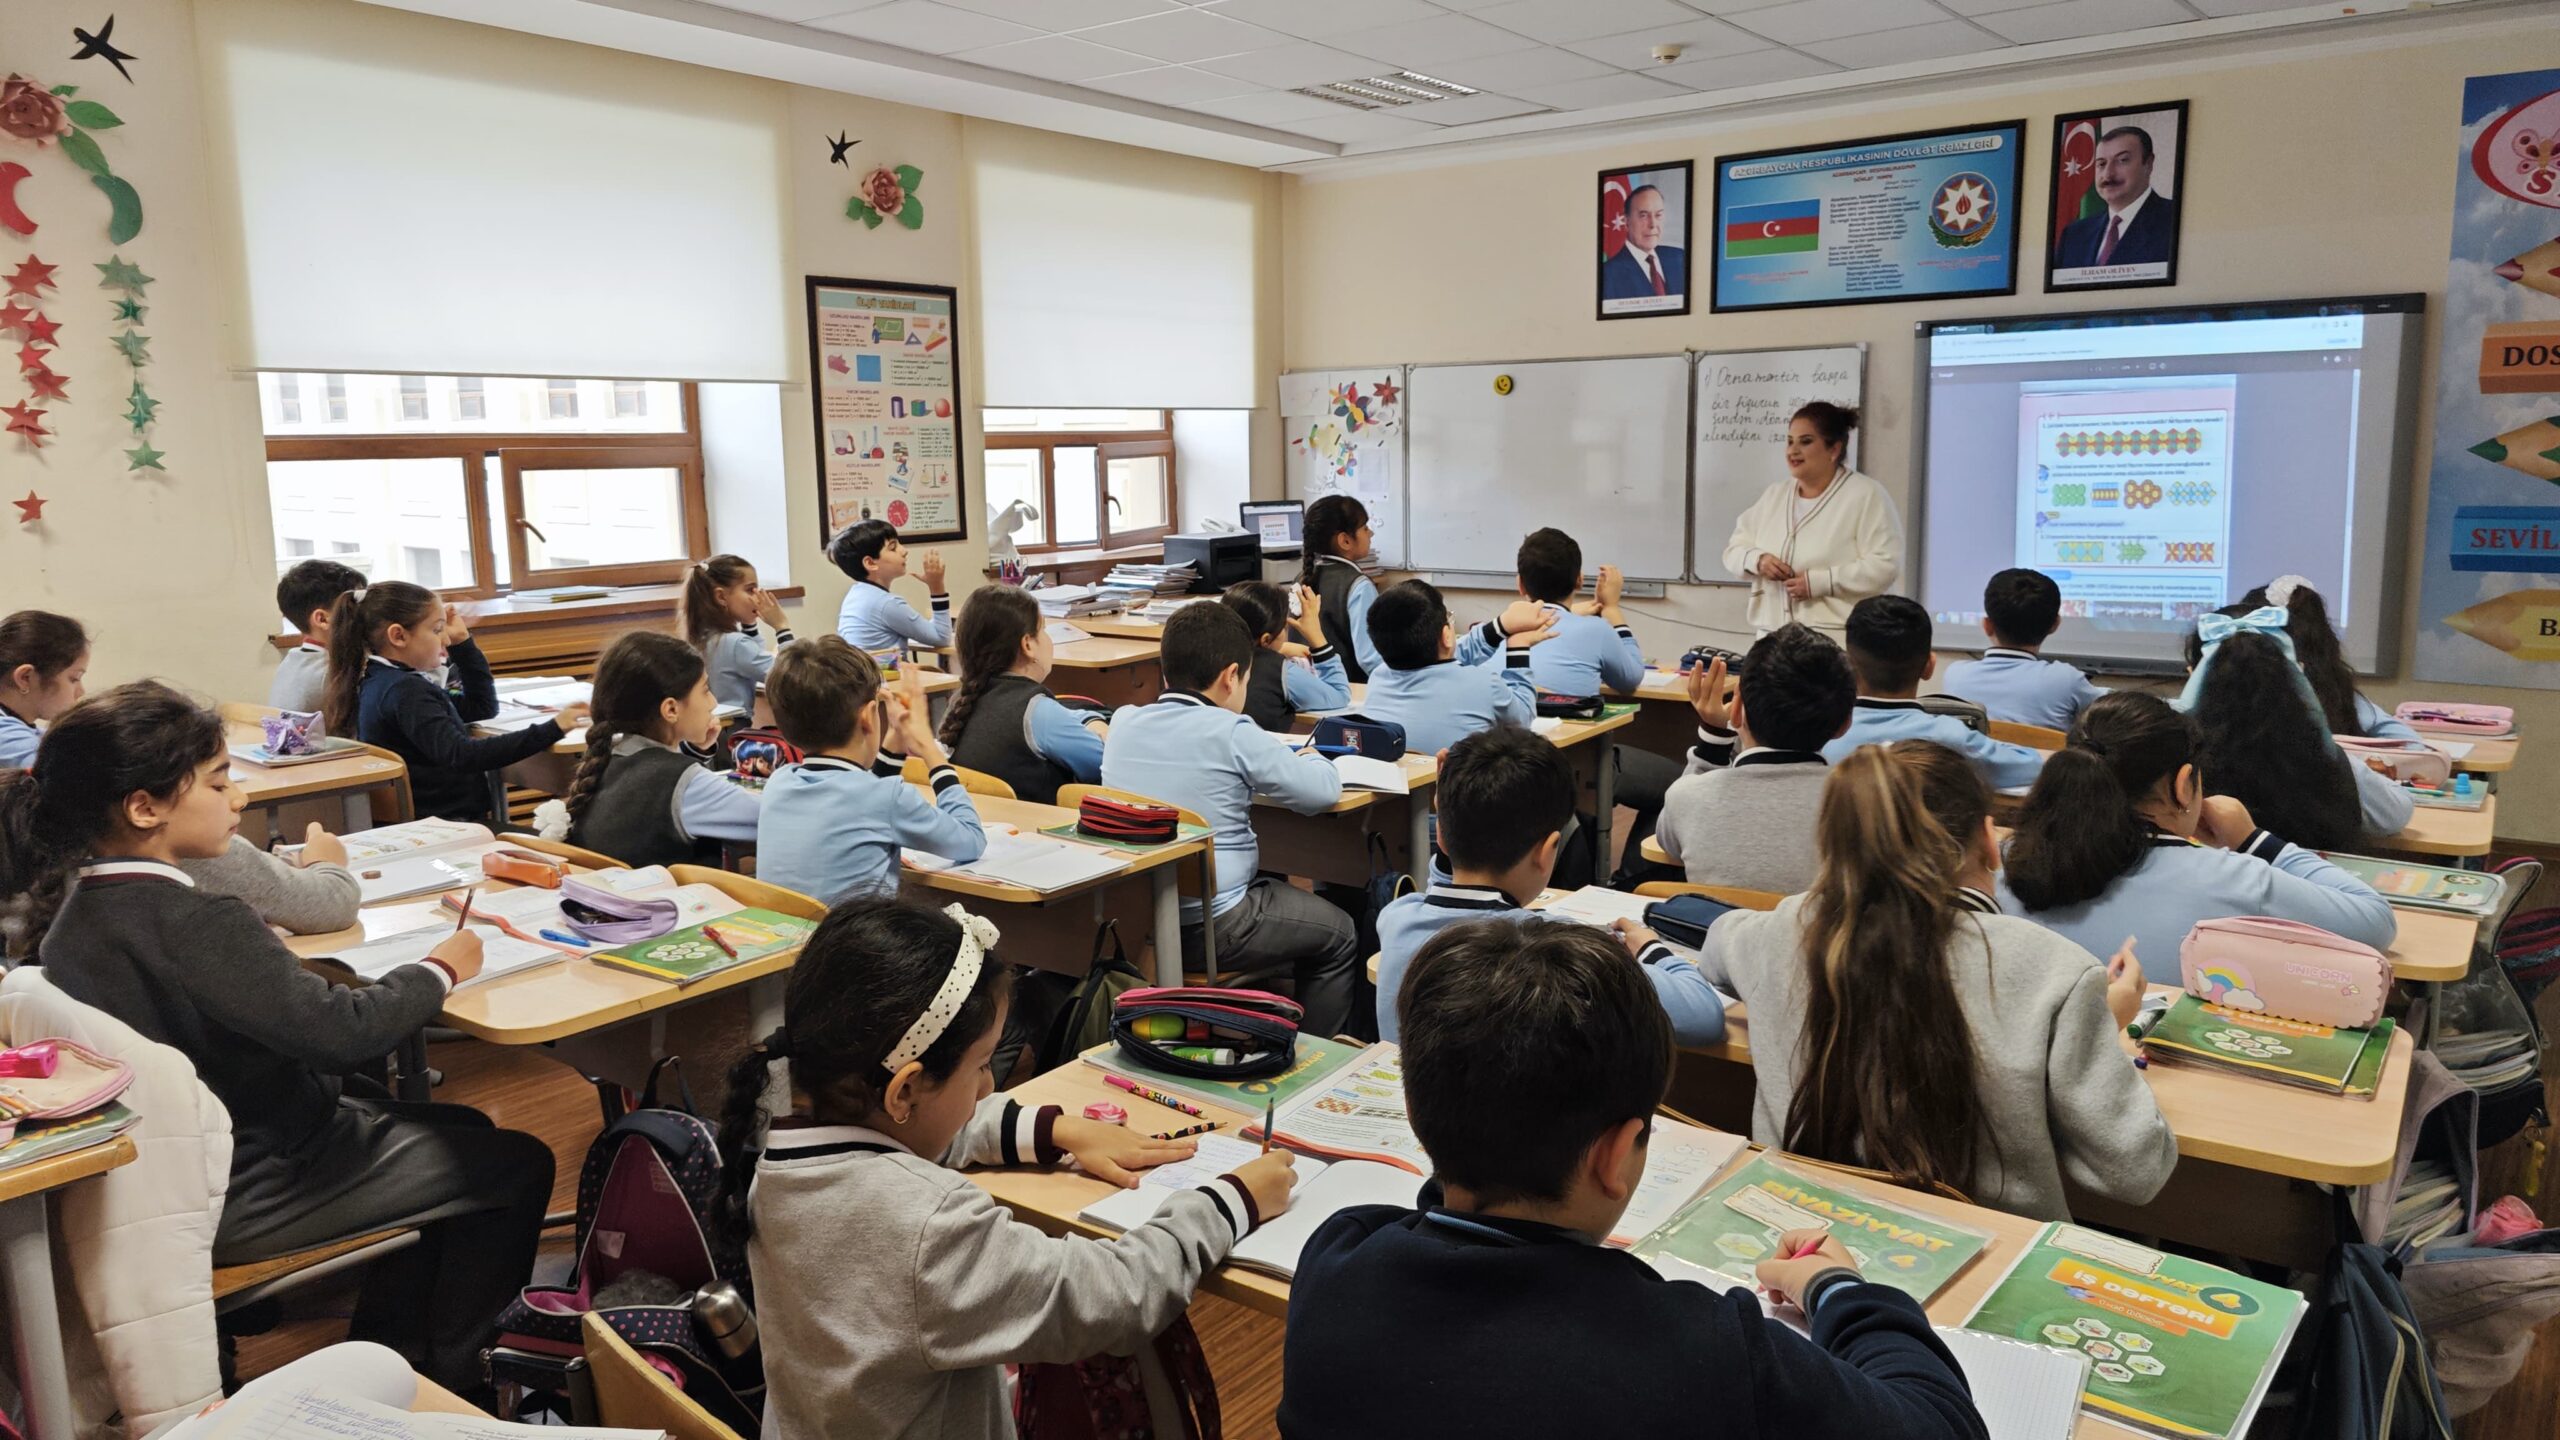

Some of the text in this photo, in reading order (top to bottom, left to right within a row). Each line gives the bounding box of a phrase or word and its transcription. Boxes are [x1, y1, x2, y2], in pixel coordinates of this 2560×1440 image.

[2526, 169, 2557, 195] S
[2540, 618, 2560, 636] B
[2285, 961, 2351, 983] UNICORN
[1762, 1180, 1954, 1252] RİYAZİYYAT
[1888, 1254, 1918, 1269] 4
[2103, 1281, 2216, 1326] DƏFTƏRİ
[2209, 1292, 2242, 1309] 4
